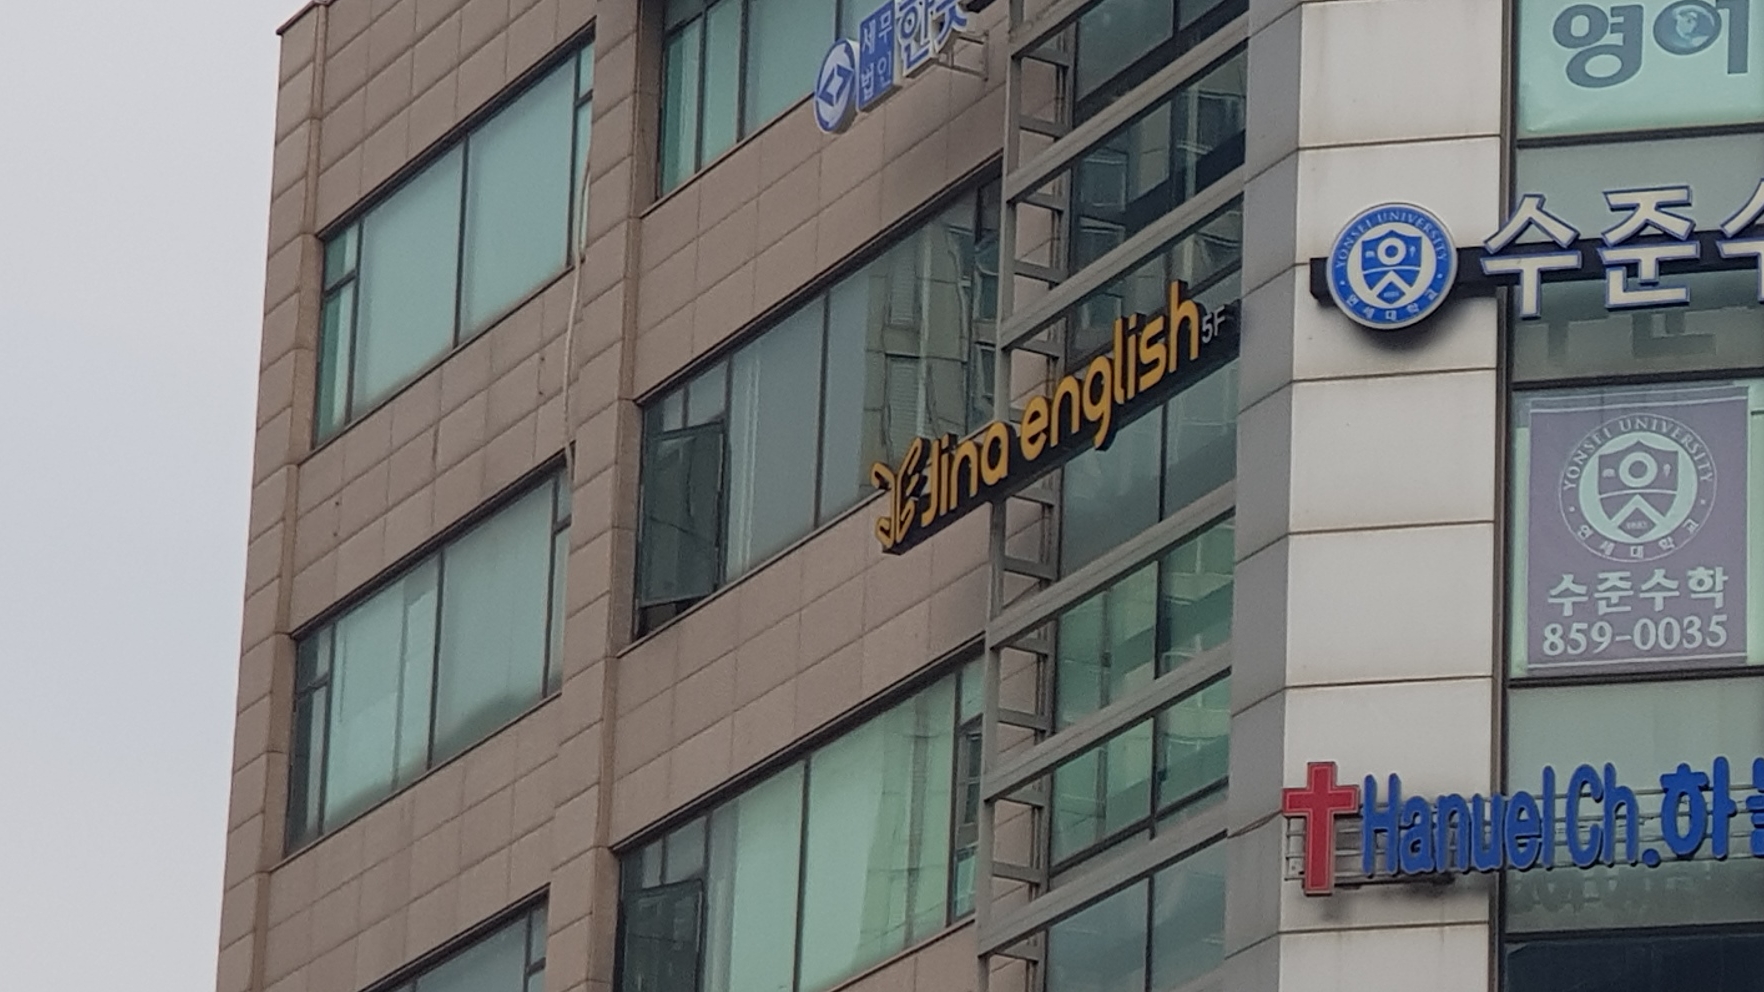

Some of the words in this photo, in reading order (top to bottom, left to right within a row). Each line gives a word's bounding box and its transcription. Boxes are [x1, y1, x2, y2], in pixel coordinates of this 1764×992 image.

[861, 10, 893, 55] 세무
[861, 50, 893, 102] 법인
[1335, 219, 1372, 268] YONSEI
[1377, 210, 1448, 260] UNIVERSITY
[1020, 279, 1199, 461] english
[1202, 307, 1226, 345] 5F
[1564, 427, 1611, 491] YONSEI
[1619, 416, 1714, 484] UNIVERSITY
[1547, 566, 1729, 617] 수준수학
[1542, 614, 1728, 656] 859-0035
[1362, 765, 1556, 877] Hanuel
